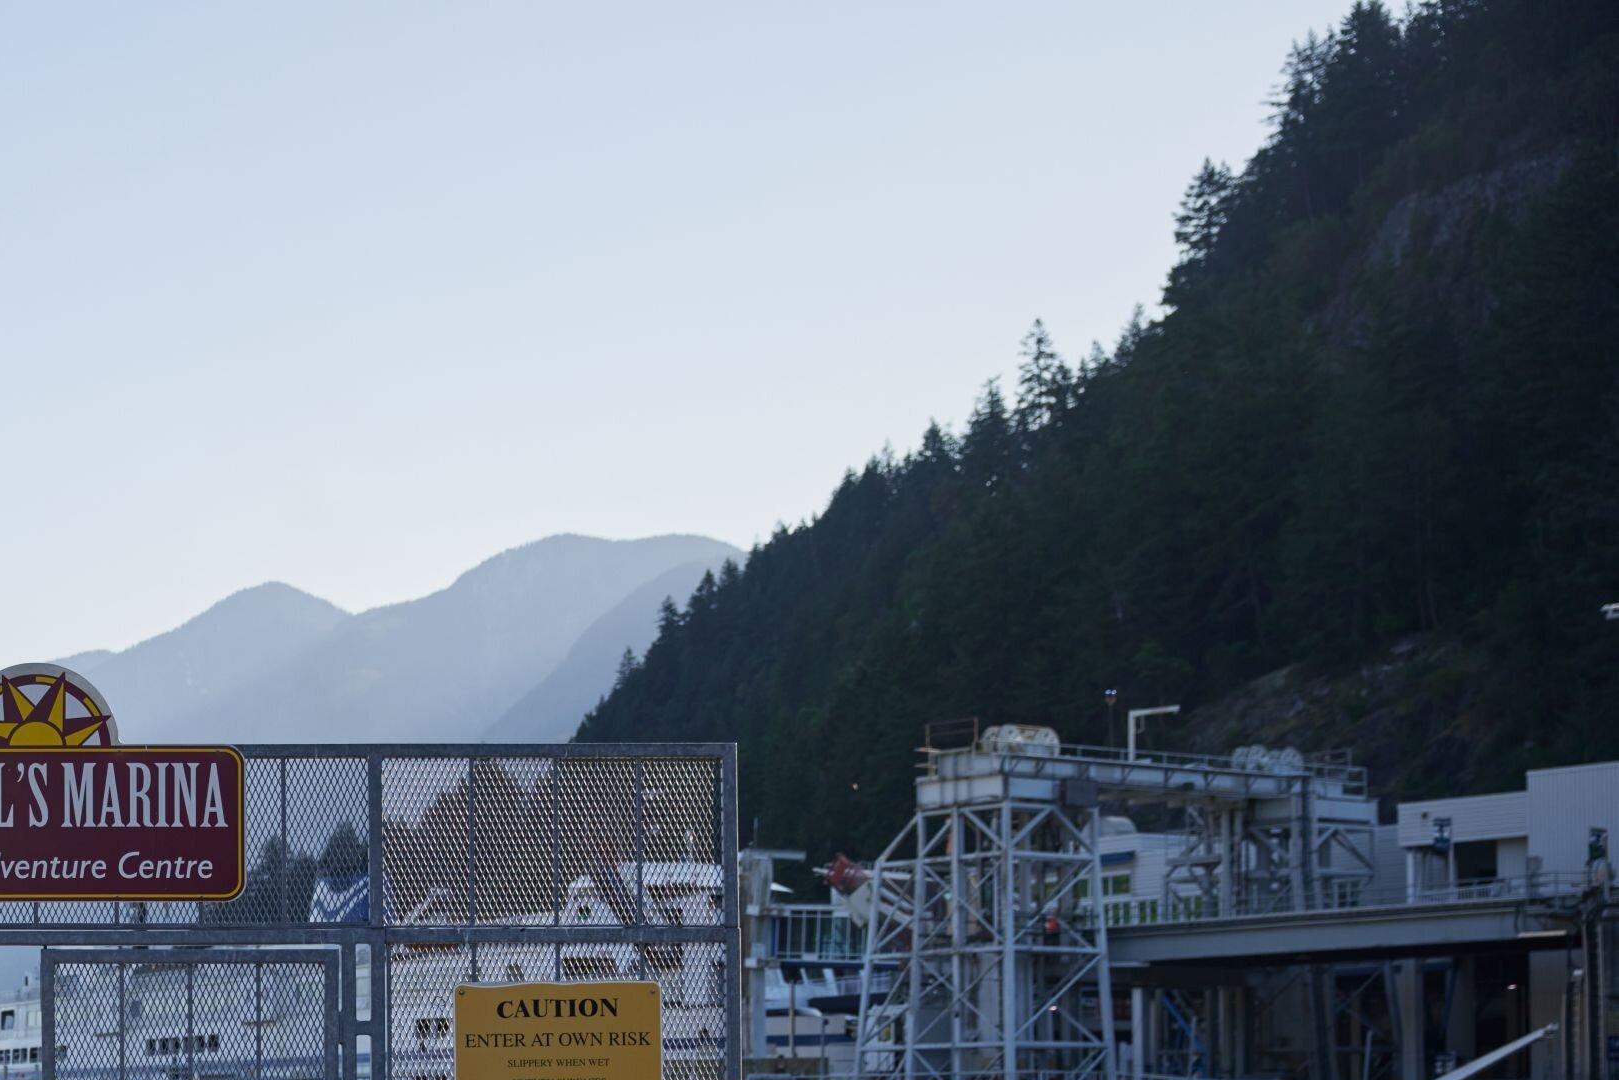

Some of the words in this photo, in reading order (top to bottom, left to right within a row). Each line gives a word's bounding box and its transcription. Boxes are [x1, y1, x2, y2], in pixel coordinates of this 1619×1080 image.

[61, 763, 228, 827] MARINA
[119, 852, 212, 878] Centre
[496, 998, 619, 1019] CAUTION
[466, 1034, 525, 1047] ENTER
[532, 1033, 553, 1046] AT
[559, 1033, 602, 1046] OWN
[610, 1032, 650, 1045] RISK
[508, 1059, 553, 1068] SLIPPERY
[556, 1058, 586, 1067] WHEN
[589, 1058, 610, 1067] WET
